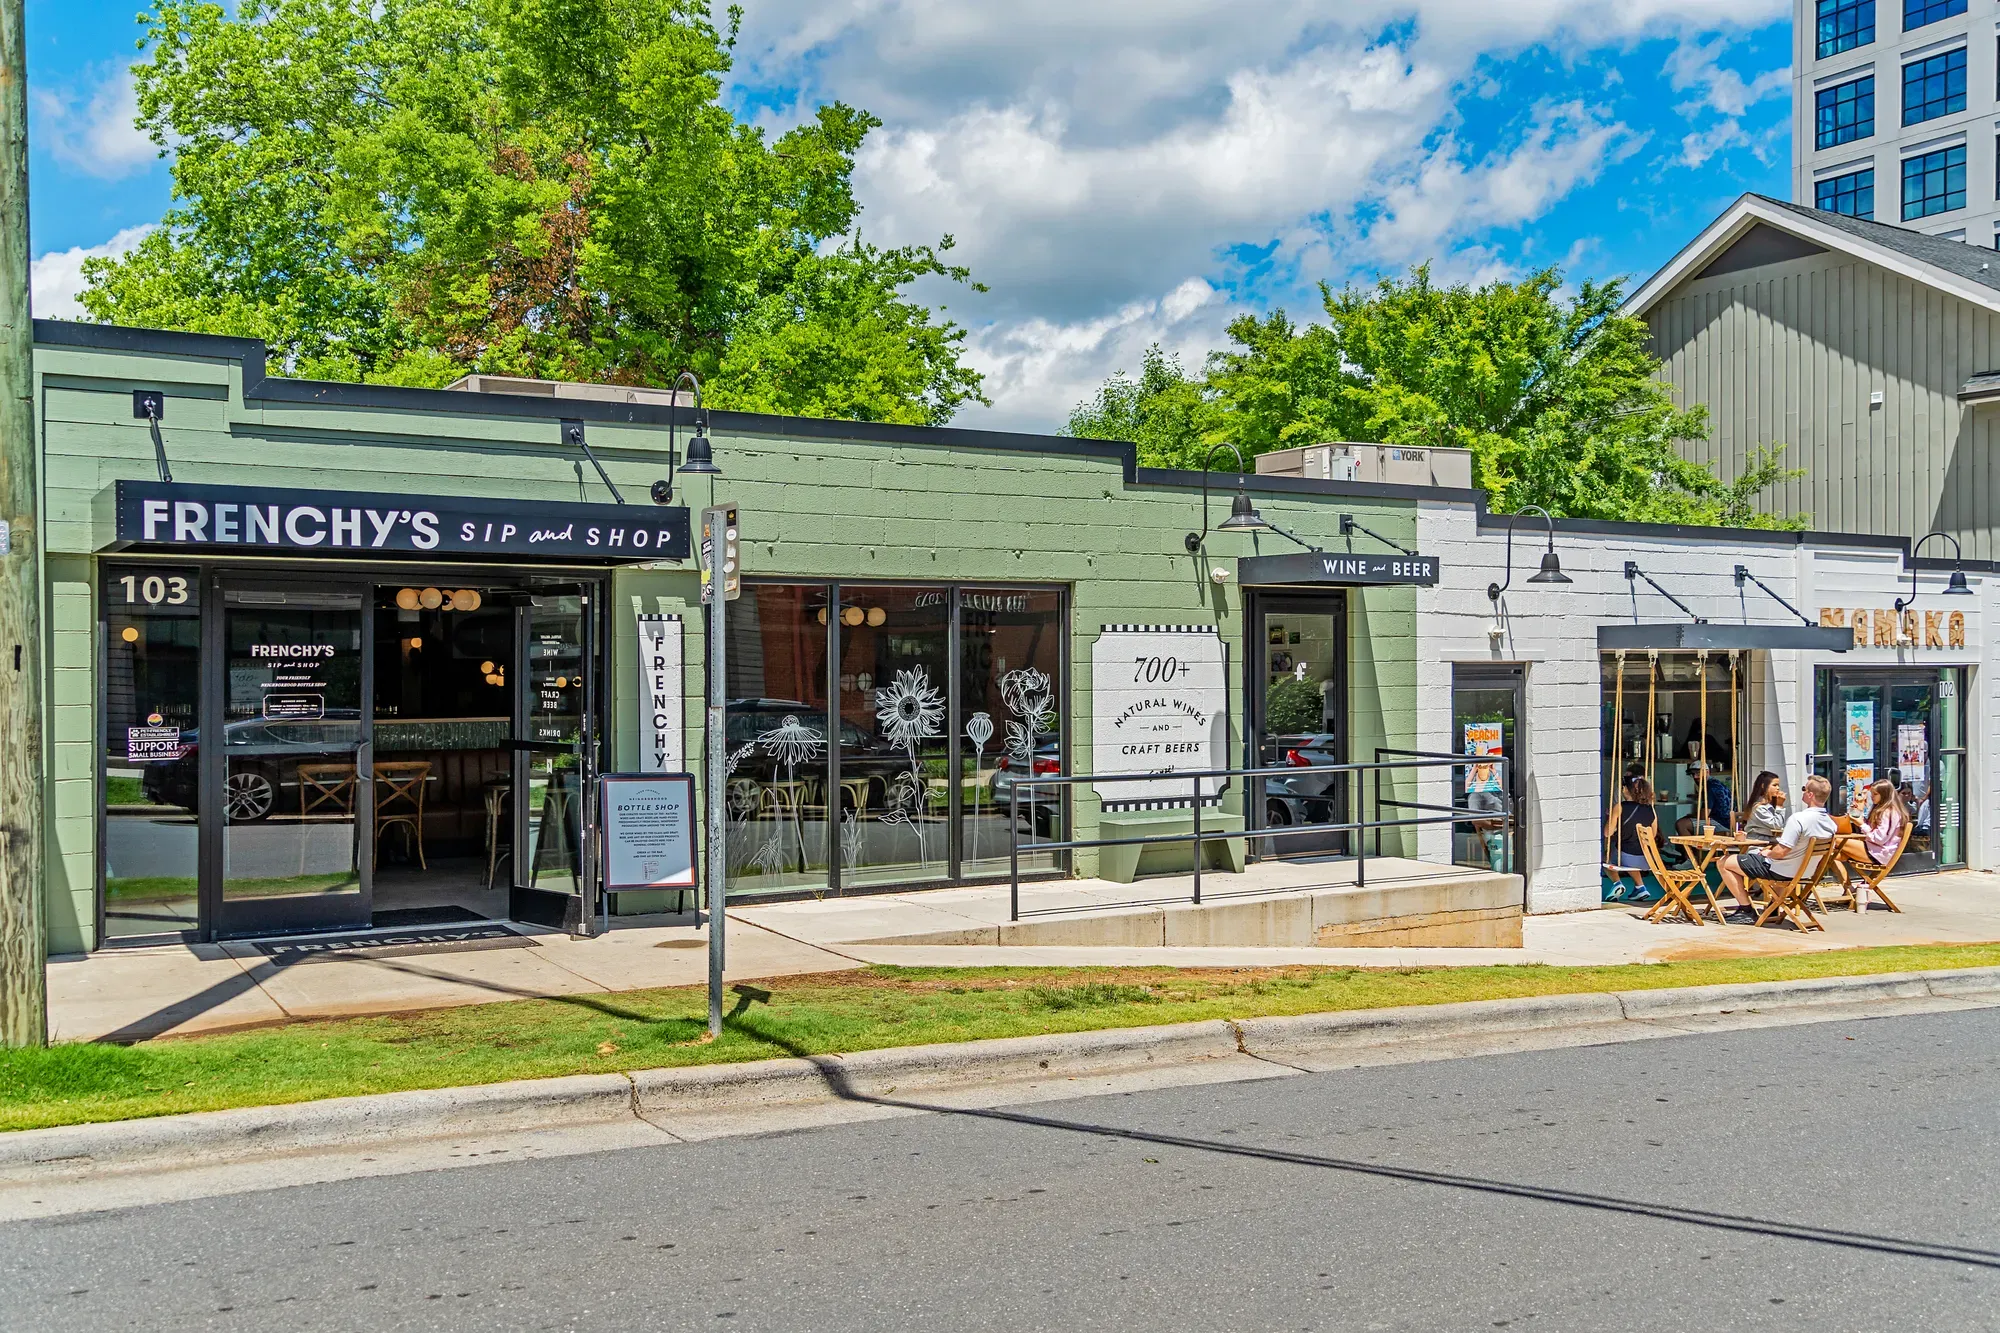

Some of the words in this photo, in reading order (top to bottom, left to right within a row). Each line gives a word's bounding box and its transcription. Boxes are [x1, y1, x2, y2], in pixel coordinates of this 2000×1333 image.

[1400, 451, 1424, 462] YORK
[143, 500, 440, 549] FRENCHY'S
[460, 522, 517, 542] SIP
[529, 524, 573, 543] and
[586, 527, 671, 548] SHOP
[1323, 560, 1366, 575] WINE
[1372, 564, 1386, 572] and
[1392, 562, 1431, 577] BEER
[120, 575, 188, 605] 103
[251, 645, 335, 657] FRENCHY'S
[1134, 656, 1190, 683] 700+
[1939, 682, 1954, 697] 102
[652, 636, 670, 768] FRENCHY'
[1114, 698, 1167, 728] NATURAL
[1173, 699, 1206, 727] WINES
[1152, 724, 1170, 732] AND
[1467, 729, 1499, 741] PEACH!
[128, 741, 179, 752] SUPPORT
[1122, 744, 1161, 755] CRAFT
[1165, 743, 1200, 753] BEERS
[272, 929, 508, 954] FRENCHY'S
